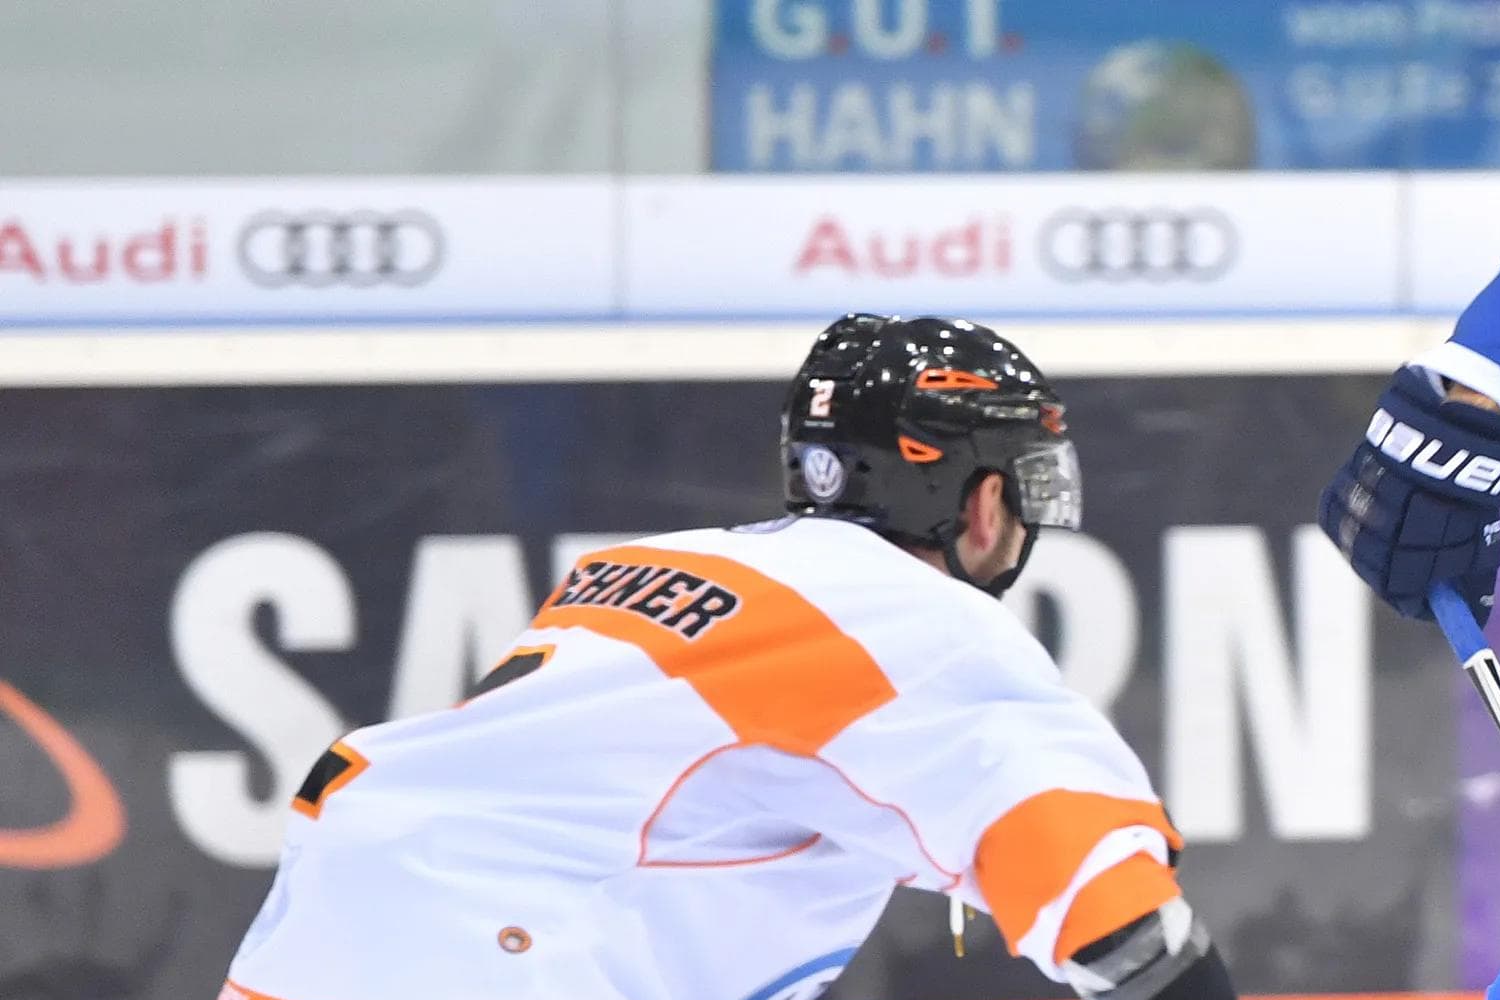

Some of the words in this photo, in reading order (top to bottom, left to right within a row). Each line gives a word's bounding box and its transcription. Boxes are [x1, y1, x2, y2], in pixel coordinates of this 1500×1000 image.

[748, 80, 1035, 167] HAHN
[0, 216, 208, 283] Audi
[794, 214, 1013, 278] Audi
[809, 378, 835, 418] 2
